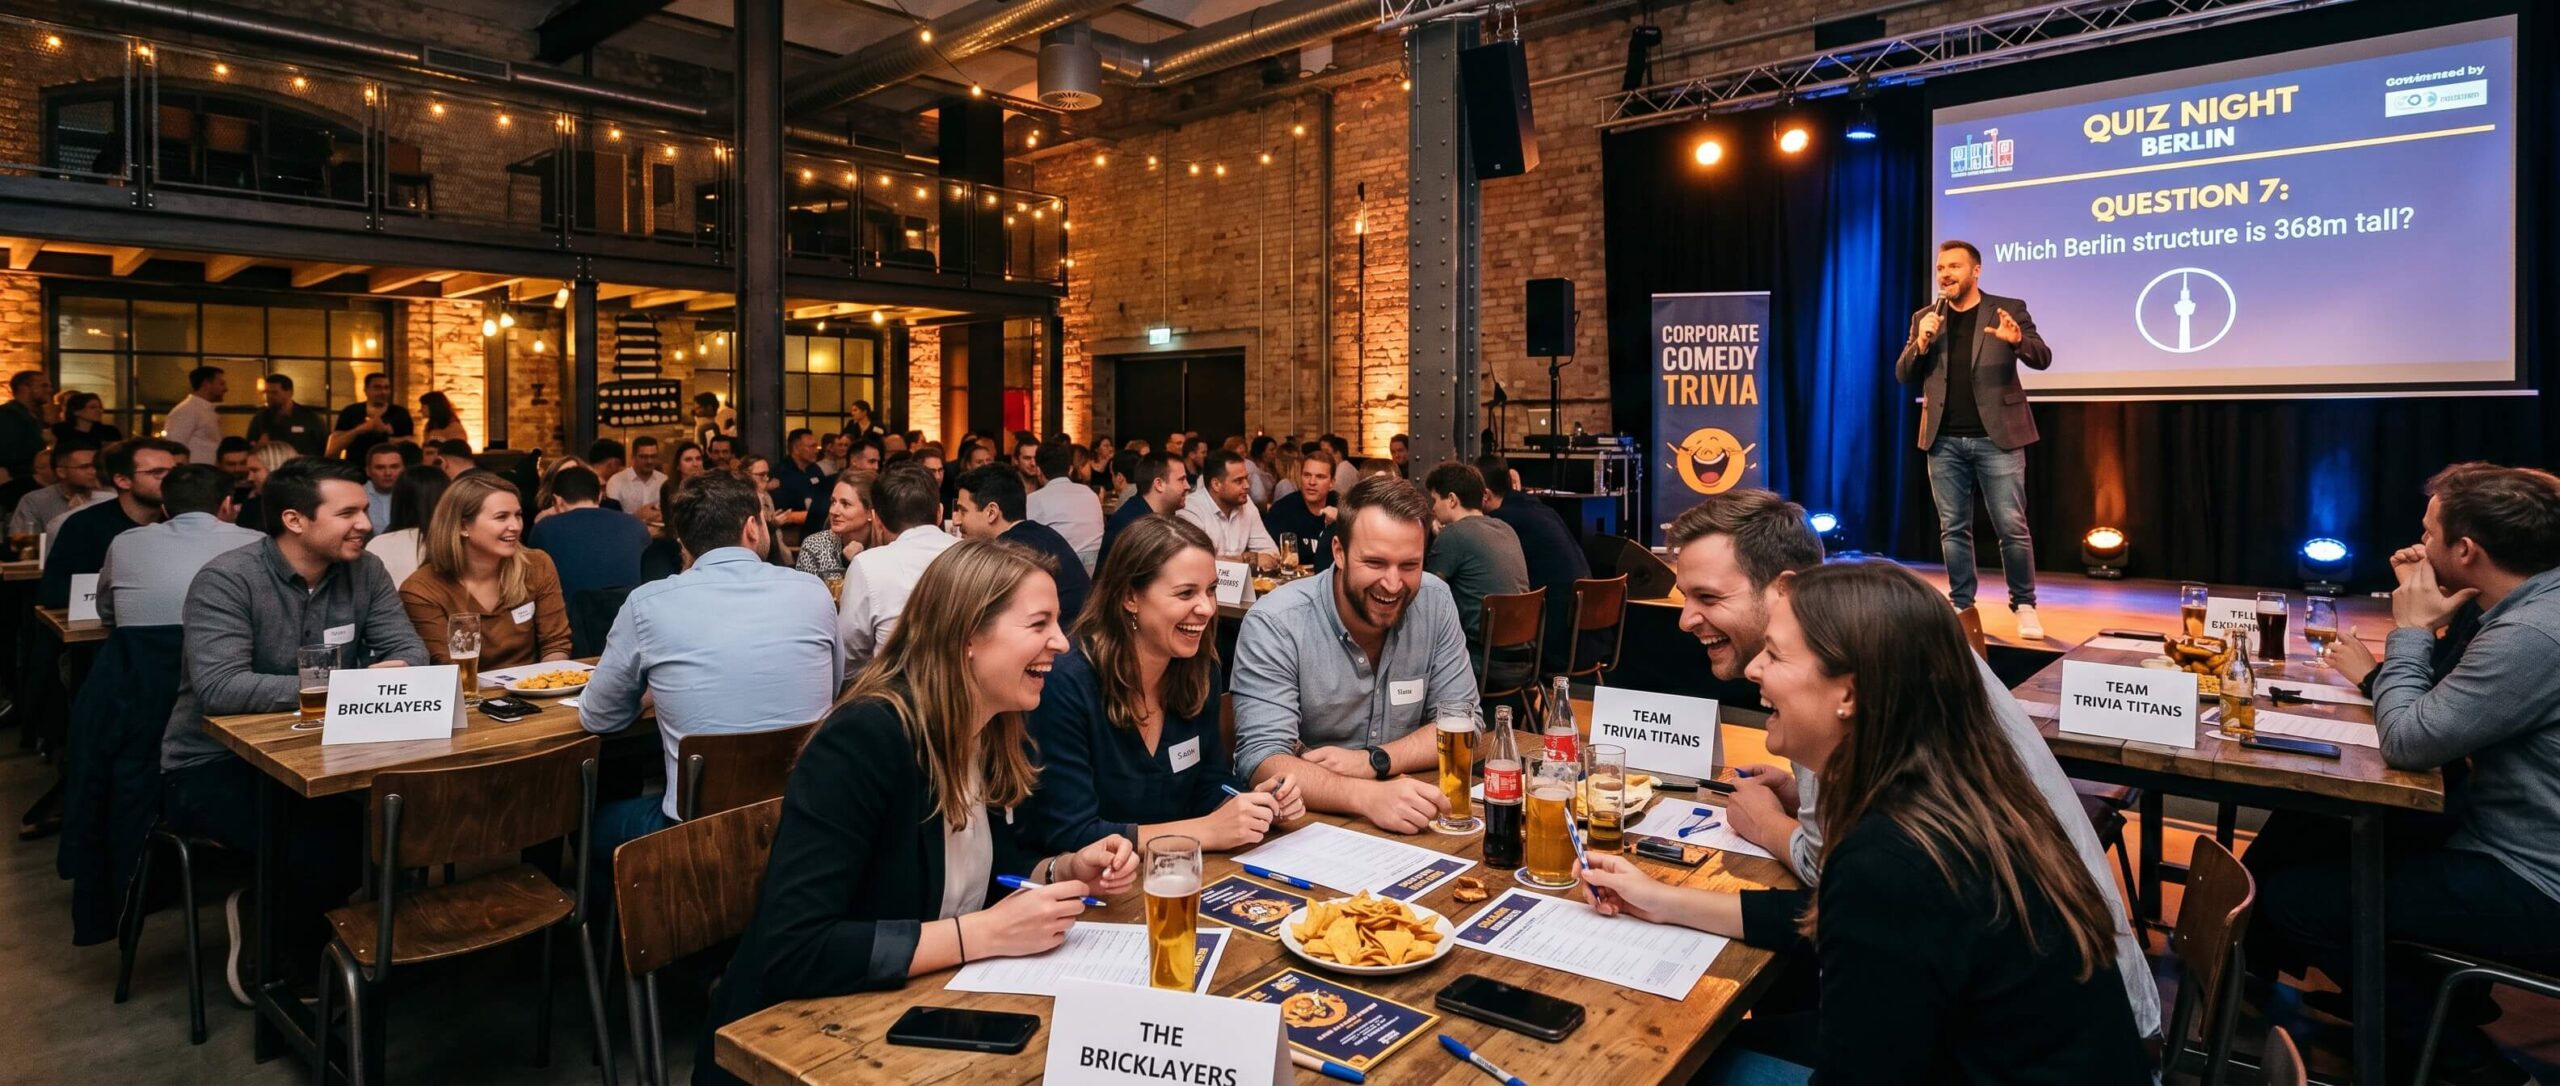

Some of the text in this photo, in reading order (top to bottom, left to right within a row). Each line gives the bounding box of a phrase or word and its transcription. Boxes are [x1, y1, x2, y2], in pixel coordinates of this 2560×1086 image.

[2468, 65, 2485, 75] by
[2083, 85, 2299, 143] QUIZ NIGHT
[2141, 126, 2235, 157] BERLIN
[2091, 178, 2289, 222] QUESTION 7:
[1994, 207, 2414, 262] Which Berlin structure is 368m tall?
[1662, 324, 1759, 343] CORPORATE
[1663, 346, 1759, 371] COMEDY
[1663, 374, 1758, 405] TRIVIA
[378, 684, 408, 695] THE
[2106, 681, 2148, 696] TEAM
[338, 700, 442, 715] BRICKLAYERS
[1633, 710, 1671, 725] TEAM
[2074, 694, 2182, 717] TRIVIA TITANS
[1603, 724, 1700, 748] TRIVIA TITANS
[1140, 1022, 1184, 1047] THE
[1080, 1046, 1237, 1086] BRICKLAYERS
